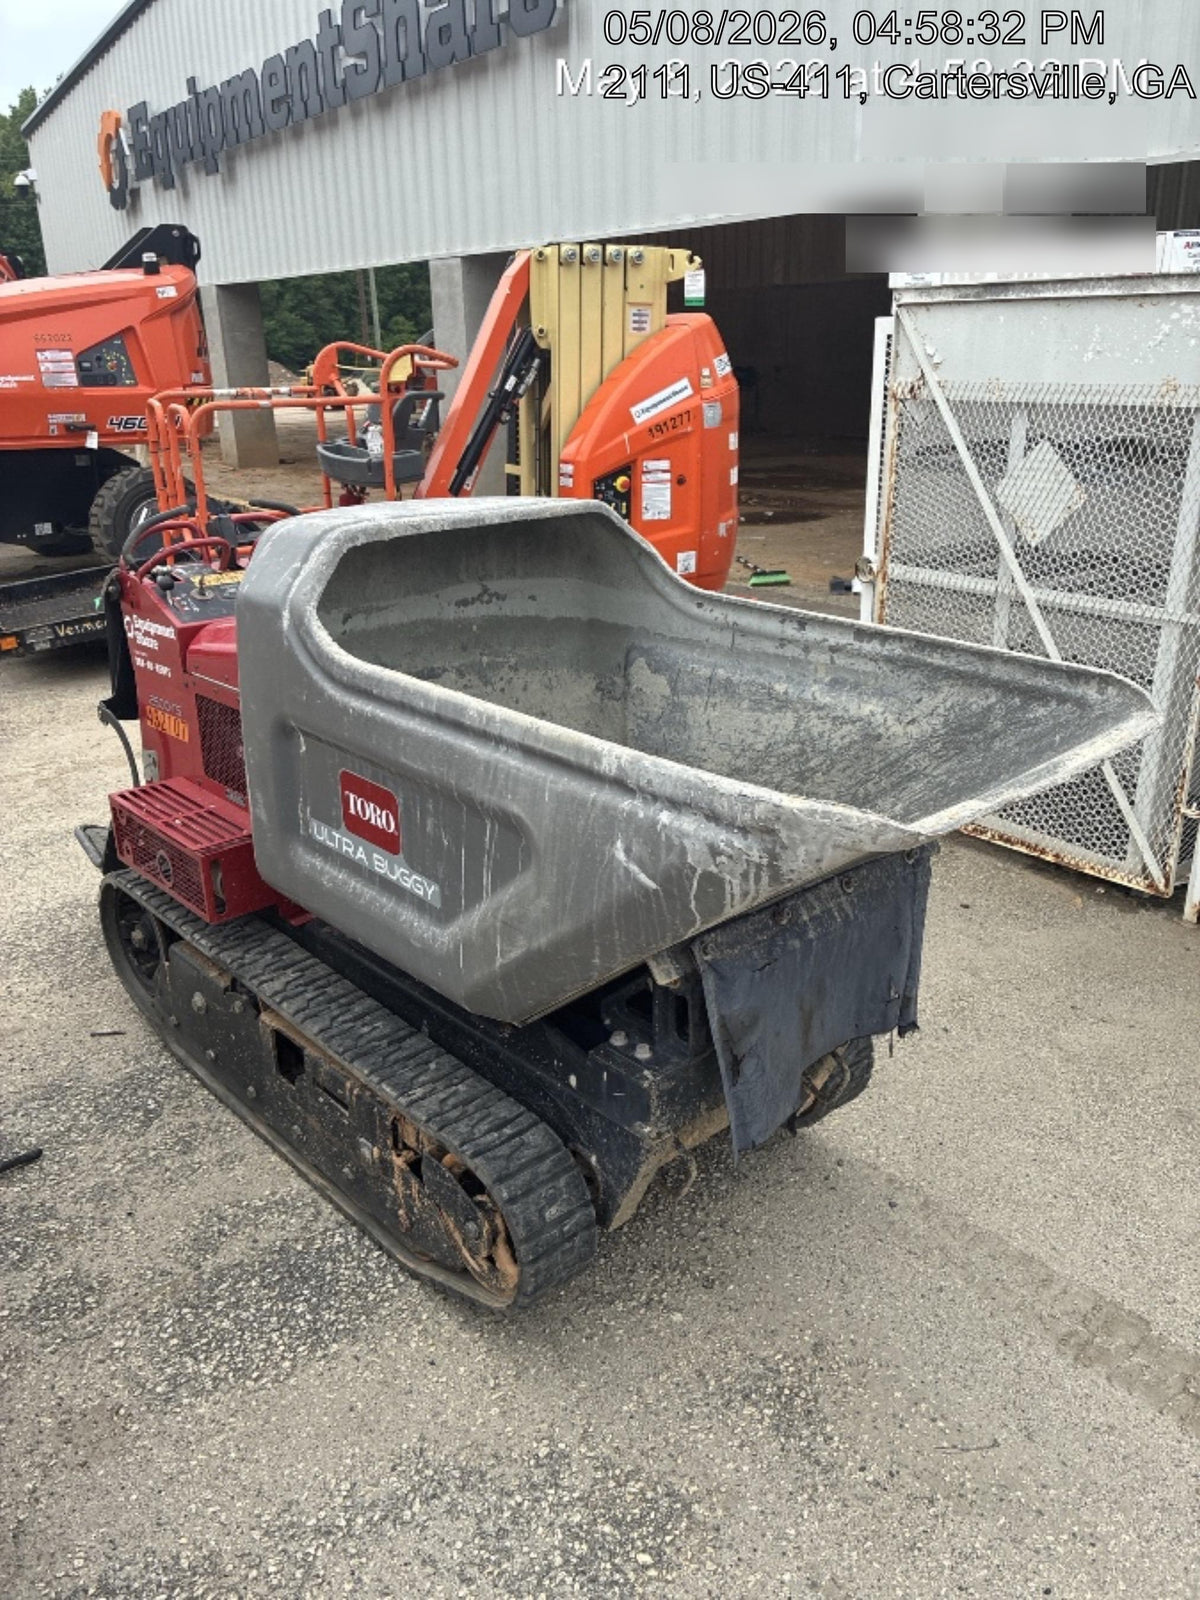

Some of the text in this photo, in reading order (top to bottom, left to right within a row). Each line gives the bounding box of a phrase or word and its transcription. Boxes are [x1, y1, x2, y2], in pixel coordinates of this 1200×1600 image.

[344, 790, 398, 834] TORO
[313, 822, 436, 901] ULTRA BUGGY
